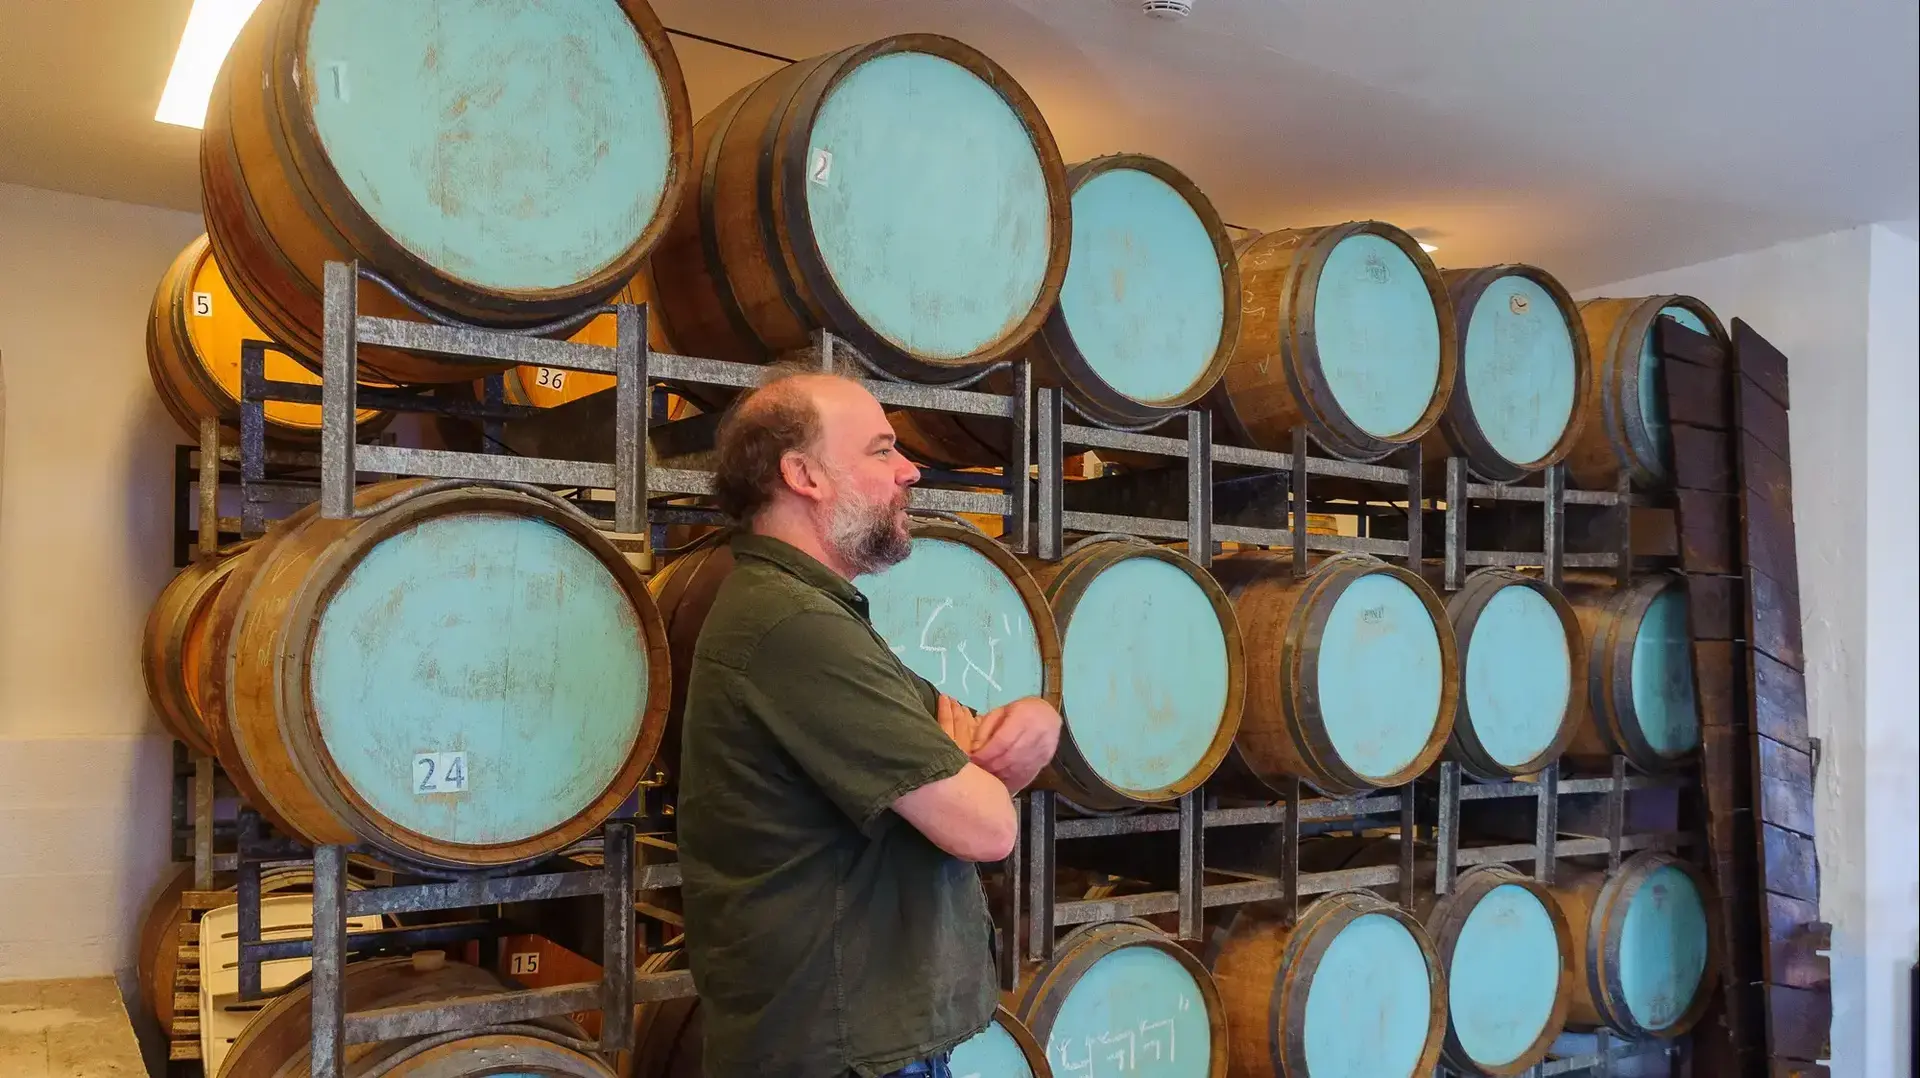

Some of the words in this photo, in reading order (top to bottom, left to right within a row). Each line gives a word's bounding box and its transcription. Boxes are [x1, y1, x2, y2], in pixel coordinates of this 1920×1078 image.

[814, 153, 828, 182] 2
[197, 295, 209, 315] 5
[538, 367, 563, 389] 36
[418, 756, 465, 791] 24
[513, 954, 537, 974] 15
